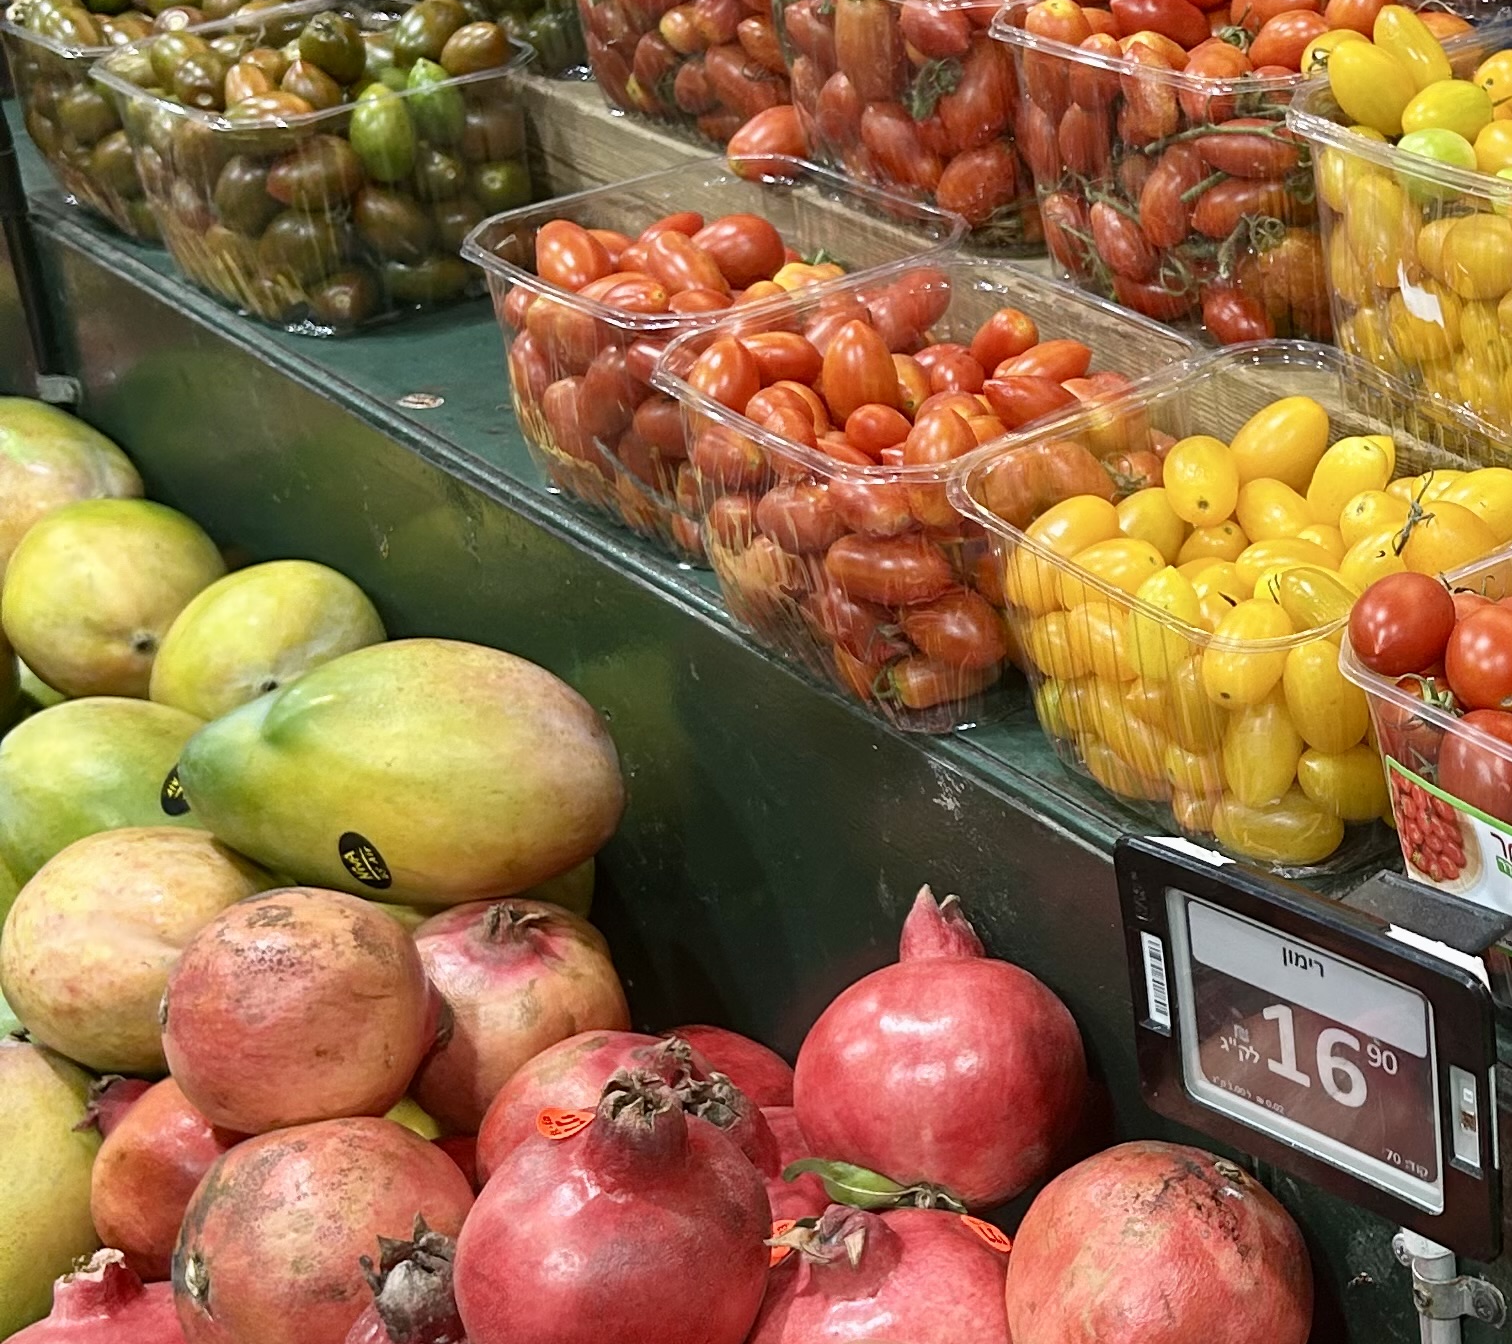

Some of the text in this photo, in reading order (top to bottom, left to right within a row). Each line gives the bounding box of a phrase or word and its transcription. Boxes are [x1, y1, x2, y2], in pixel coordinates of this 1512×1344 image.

[1282, 947, 1324, 977] רימון
[1220, 1035, 1260, 1065] לק"ג
[1262, 1004, 1398, 1107] 16 90
[1385, 1148, 1400, 1165] 70
